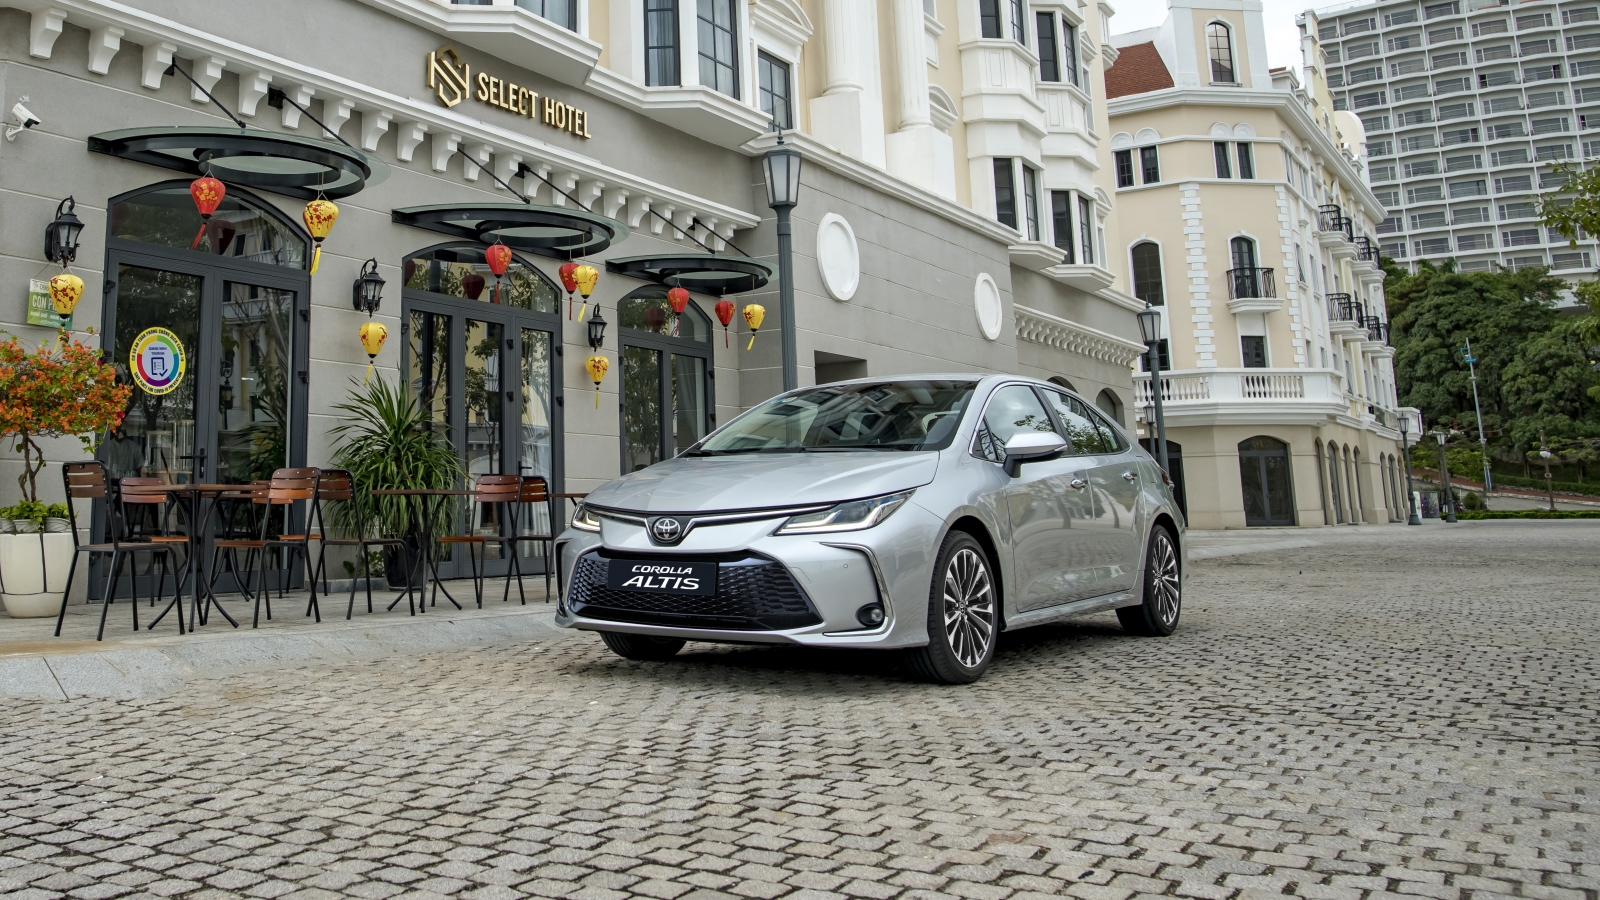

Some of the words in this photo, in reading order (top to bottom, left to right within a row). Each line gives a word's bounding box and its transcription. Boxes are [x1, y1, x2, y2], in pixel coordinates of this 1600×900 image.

[474, 71, 538, 119] SELECT
[541, 96, 592, 140] HOTEL
[631, 565, 693, 574] COROLLA
[621, 575, 700, 590] ALTIS
